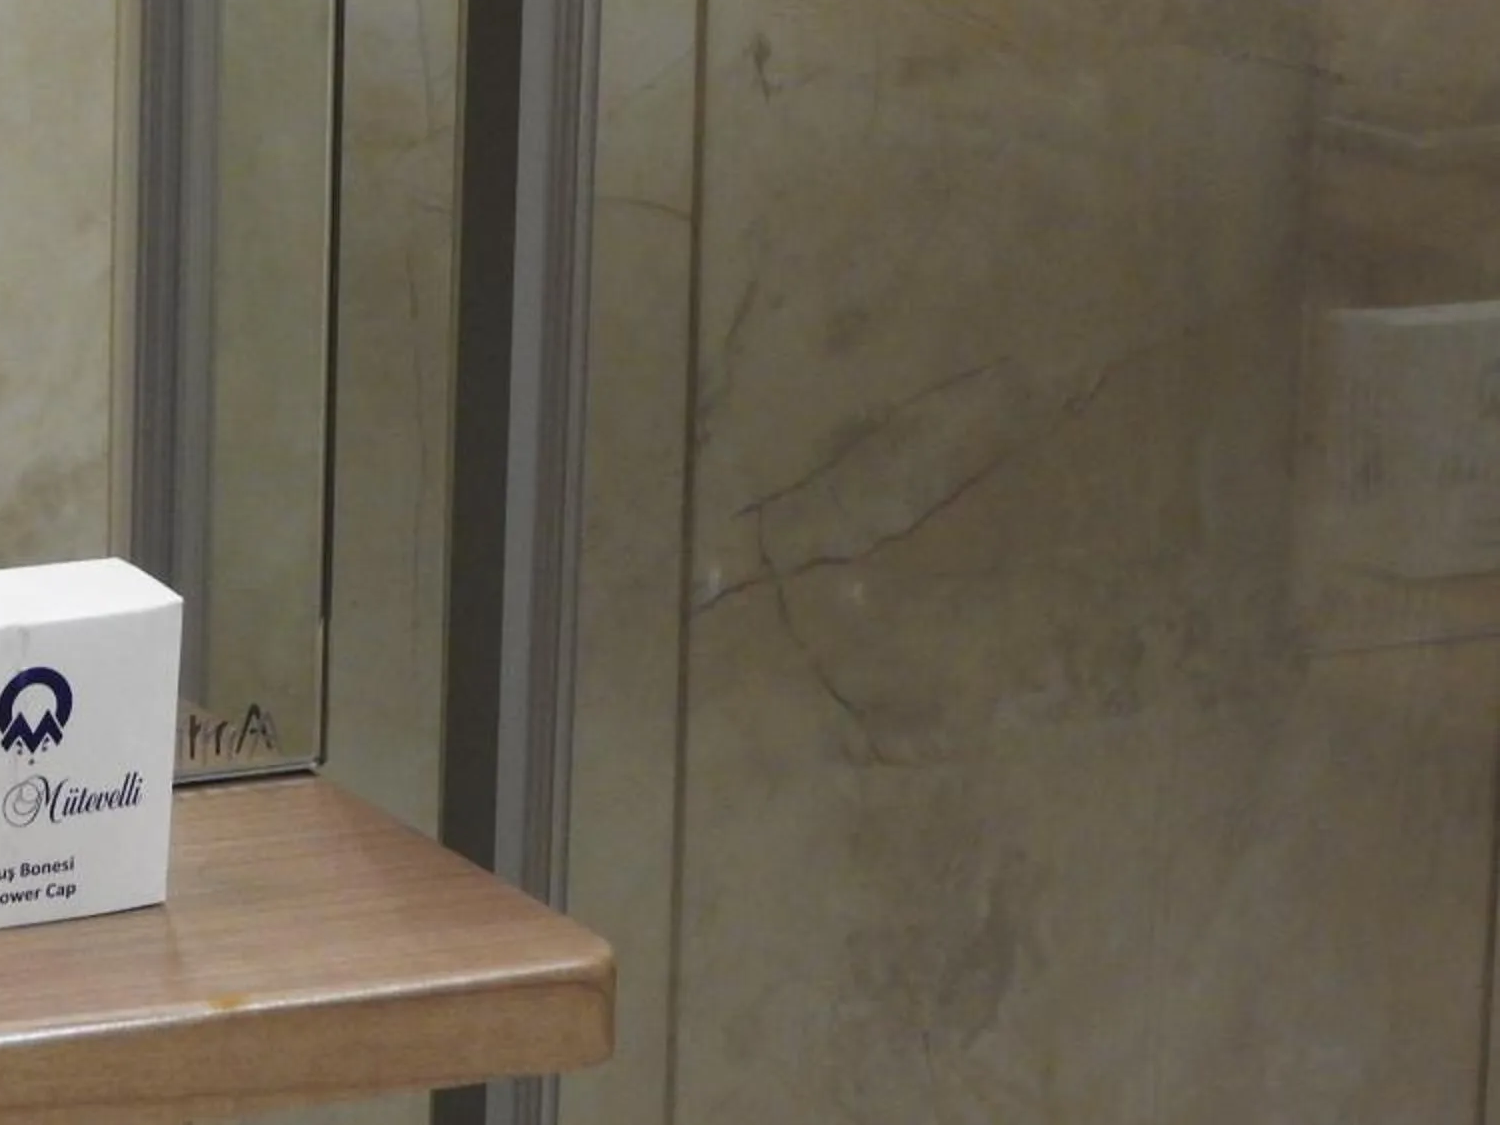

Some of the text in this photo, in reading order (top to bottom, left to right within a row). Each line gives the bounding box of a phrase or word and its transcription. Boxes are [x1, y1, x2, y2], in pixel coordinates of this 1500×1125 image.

[2, 772, 144, 827] Mütevelli
[19, 856, 76, 878] Bonesi
[45, 880, 78, 901] Cap
